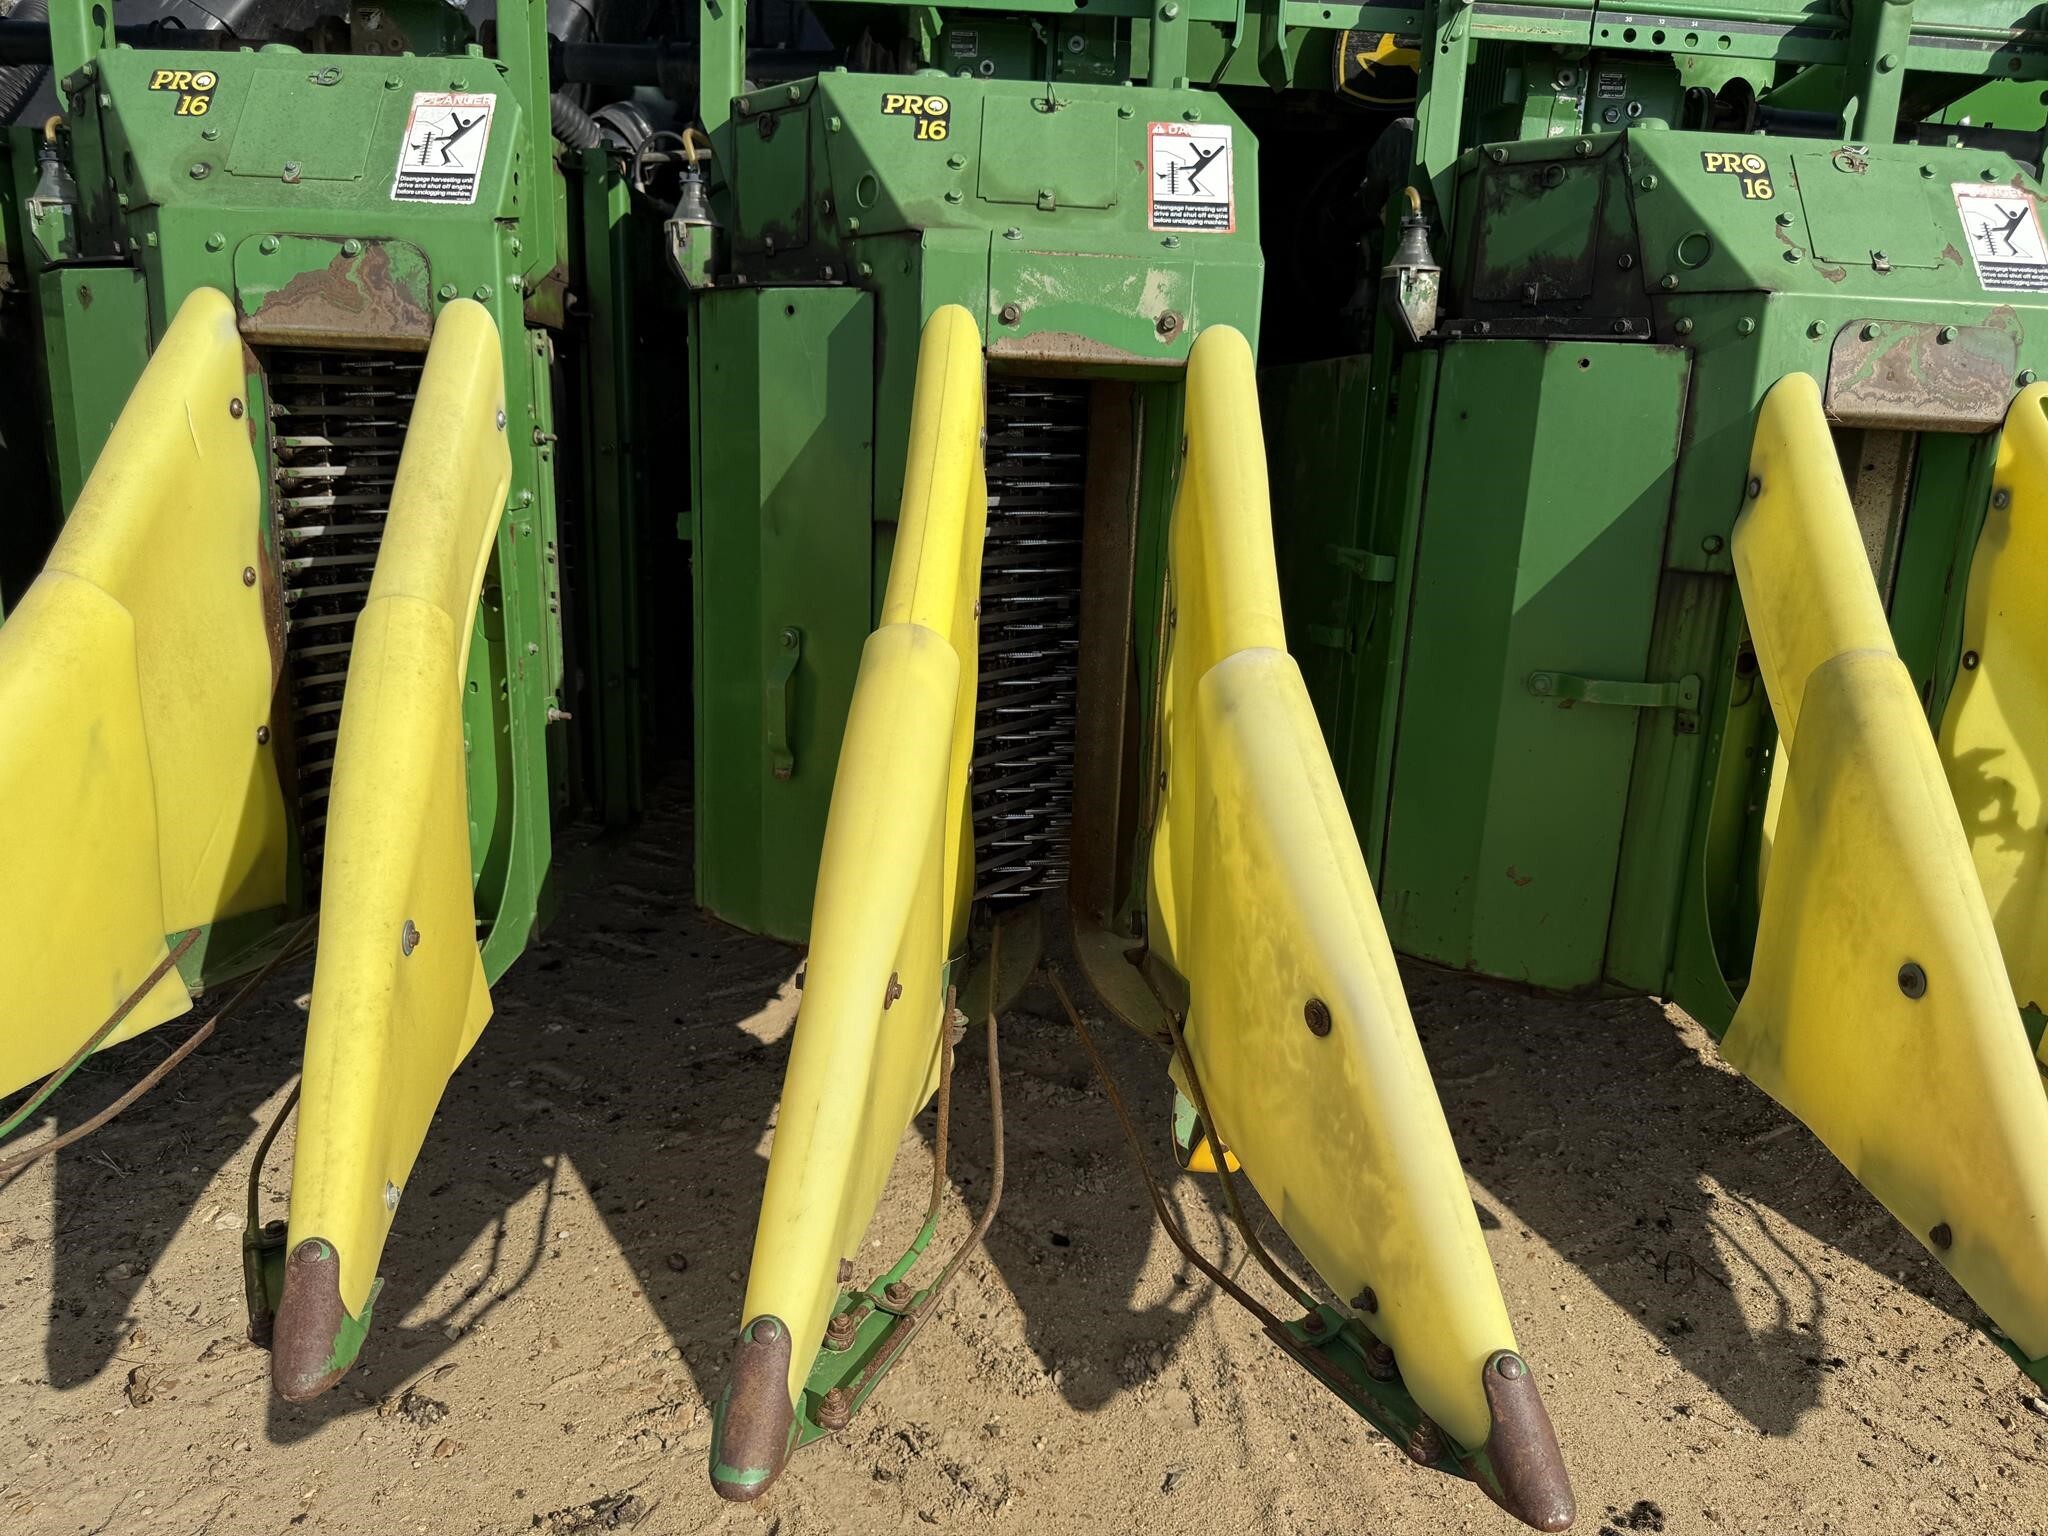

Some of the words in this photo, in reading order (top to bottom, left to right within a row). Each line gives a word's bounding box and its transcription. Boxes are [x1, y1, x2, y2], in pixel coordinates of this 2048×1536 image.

[151, 70, 217, 91] PRO
[177, 95, 210, 116] 16
[883, 94, 949, 116] PRO
[917, 119, 947, 141] 16
[1704, 152, 1766, 174] PRO
[400, 175, 431, 183] Disengage
[430, 176, 462, 184] harvesting
[1743, 178, 1773, 200] 16
[1153, 204, 1184, 212] Disengage
[1184, 205, 1216, 213] harvesting
[1172, 218, 1203, 226] unclogging
